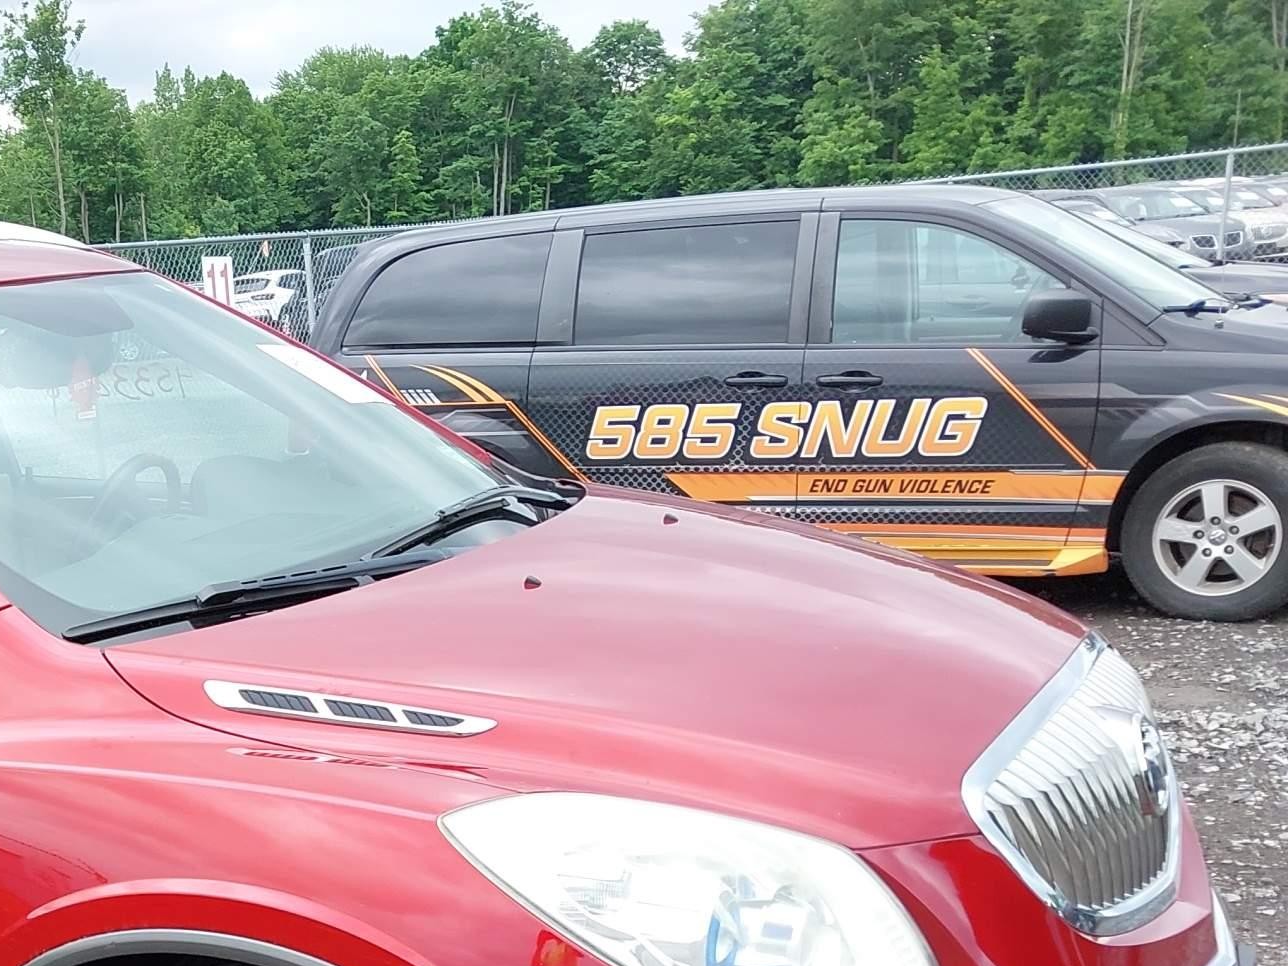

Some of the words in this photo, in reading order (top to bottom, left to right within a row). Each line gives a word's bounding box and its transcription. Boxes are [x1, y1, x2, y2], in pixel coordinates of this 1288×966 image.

[586, 402, 742, 459] 585
[749, 396, 989, 458] SNUG
[809, 478, 848, 493] END
[851, 478, 893, 494] GUN
[898, 479, 996, 494] VIOLENCE
